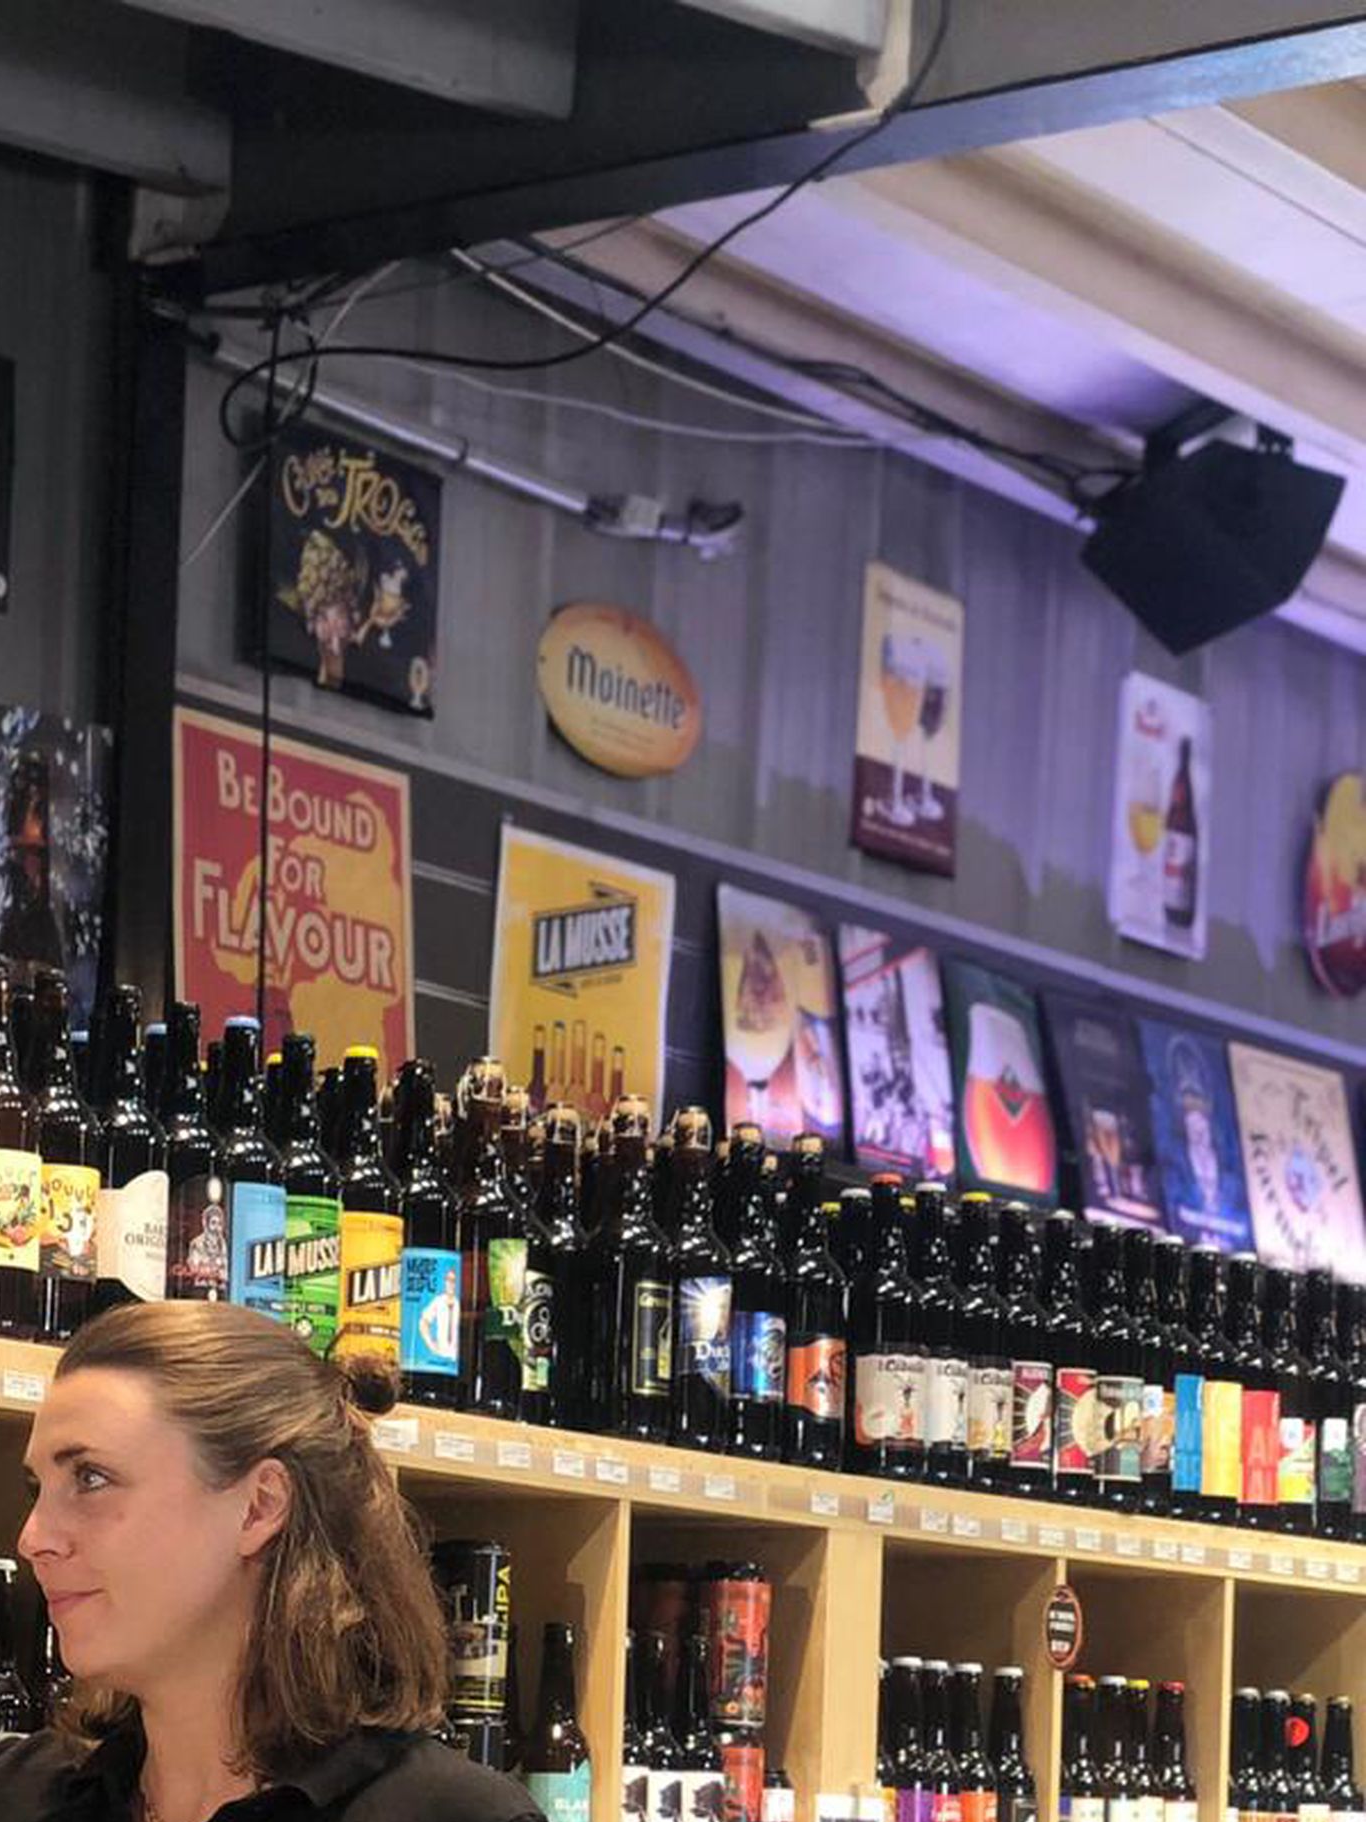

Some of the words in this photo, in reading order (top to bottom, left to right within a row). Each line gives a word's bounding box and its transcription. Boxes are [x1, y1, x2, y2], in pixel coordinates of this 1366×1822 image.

[567, 643, 683, 731] Moinette
[270, 838, 326, 897] FOR
[193, 860, 394, 992] FLAVOUR
[537, 915, 562, 976] LA
[253, 1243, 274, 1278] LA
[352, 1269, 377, 1304] LA
